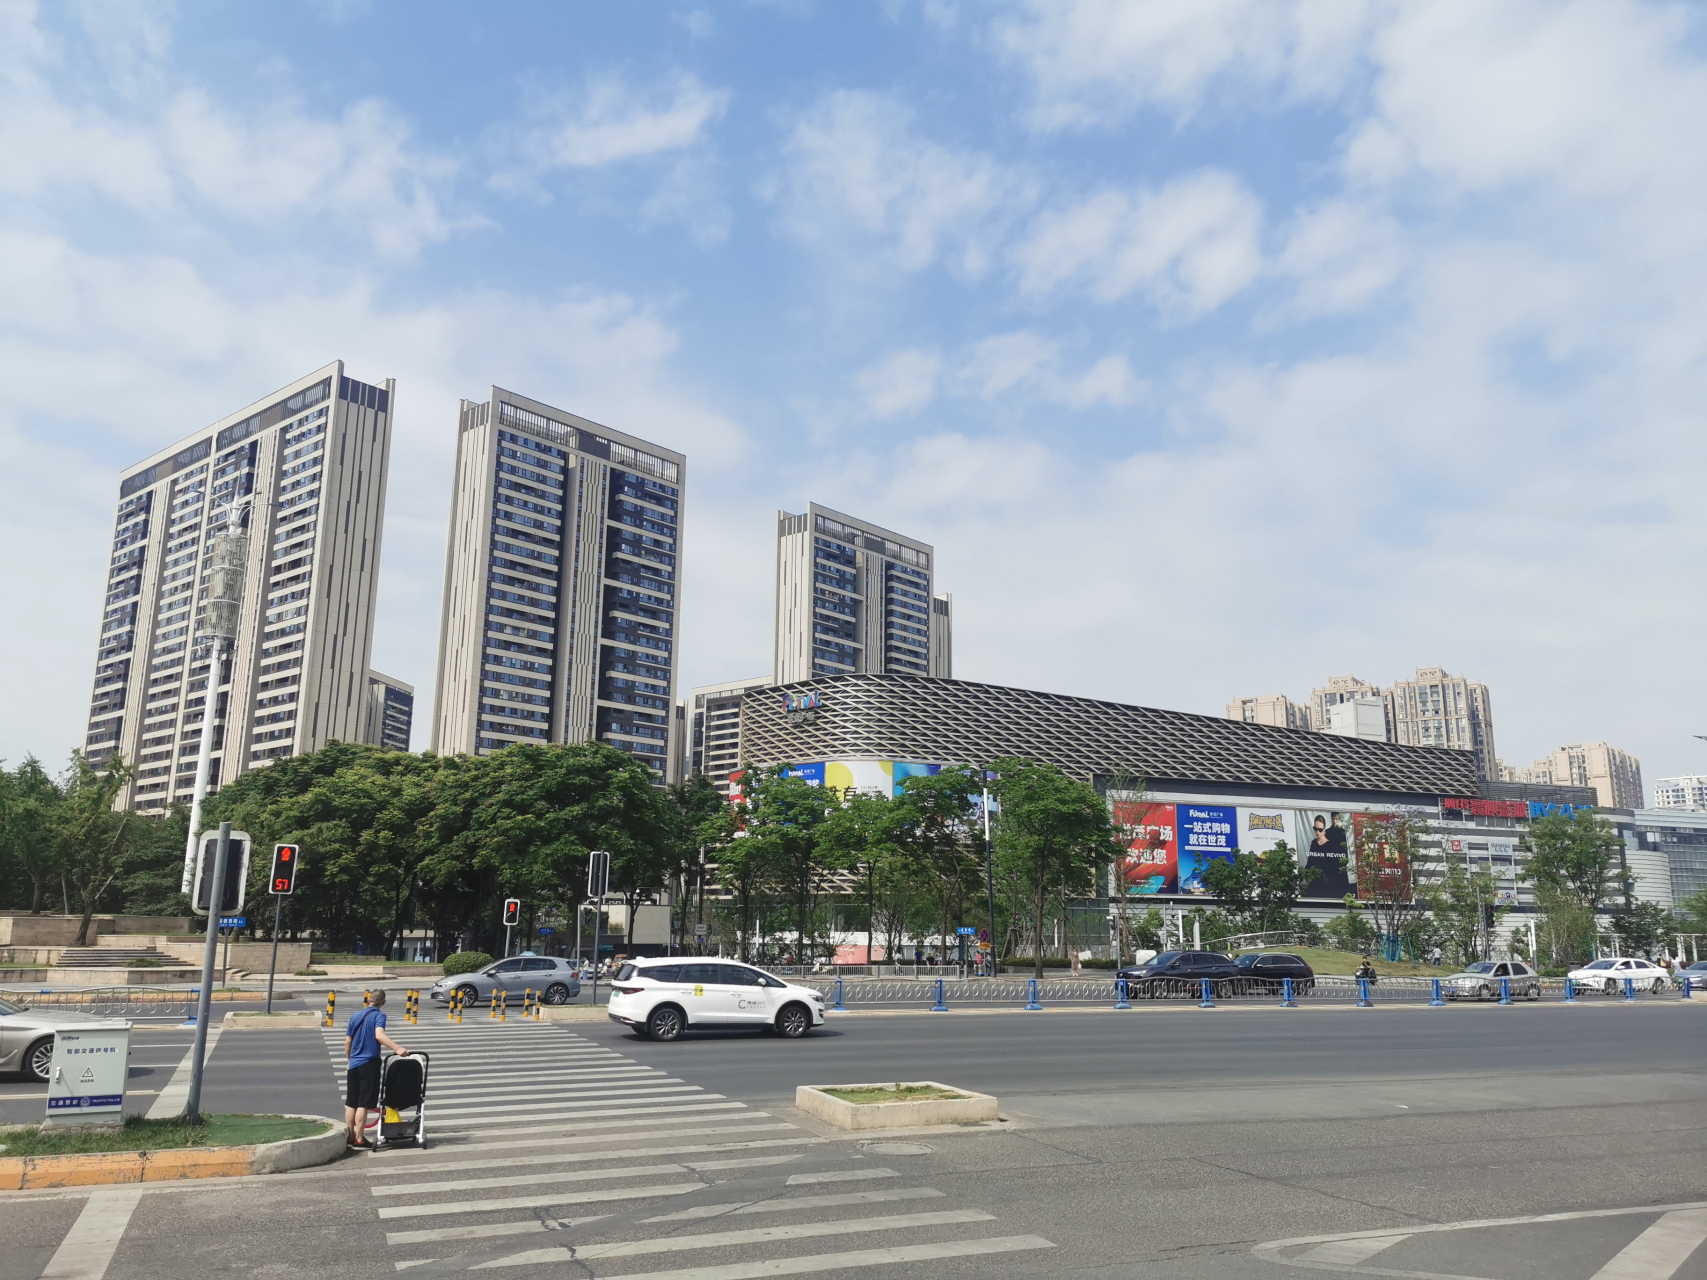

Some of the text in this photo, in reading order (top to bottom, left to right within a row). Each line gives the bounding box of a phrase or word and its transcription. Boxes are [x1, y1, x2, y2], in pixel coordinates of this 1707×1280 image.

[1184, 822, 1231, 834] 一站式购物
[1188, 834, 1226, 846] 就在世茂
[1126, 848, 1167, 865] 欢迎您
[276, 879, 288, 890] 57
